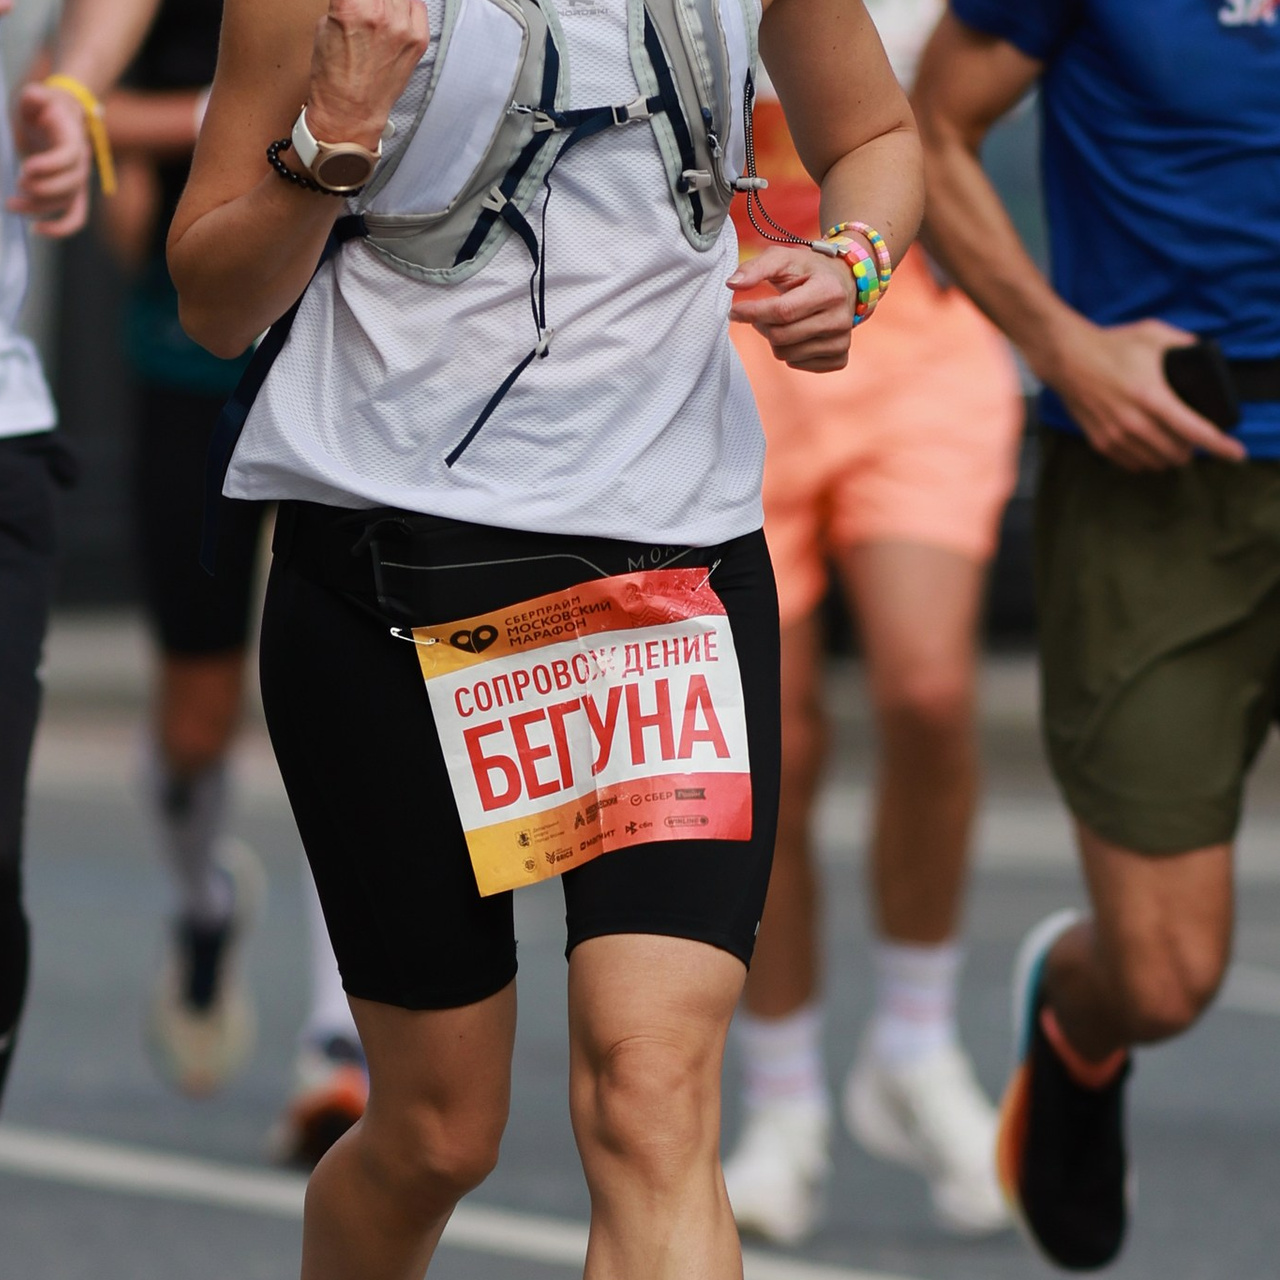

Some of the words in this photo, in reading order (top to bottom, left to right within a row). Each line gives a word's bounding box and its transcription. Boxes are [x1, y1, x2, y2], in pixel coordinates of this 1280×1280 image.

[504, 596, 581, 626] СБЕРПРАЙМ
[507, 600, 612, 637] МОСКОВСКИЙ
[510, 619, 587, 647] МАРАФОН
[463, 674, 731, 812] БЕГУНА
[645, 791, 673, 802] СБЕР
